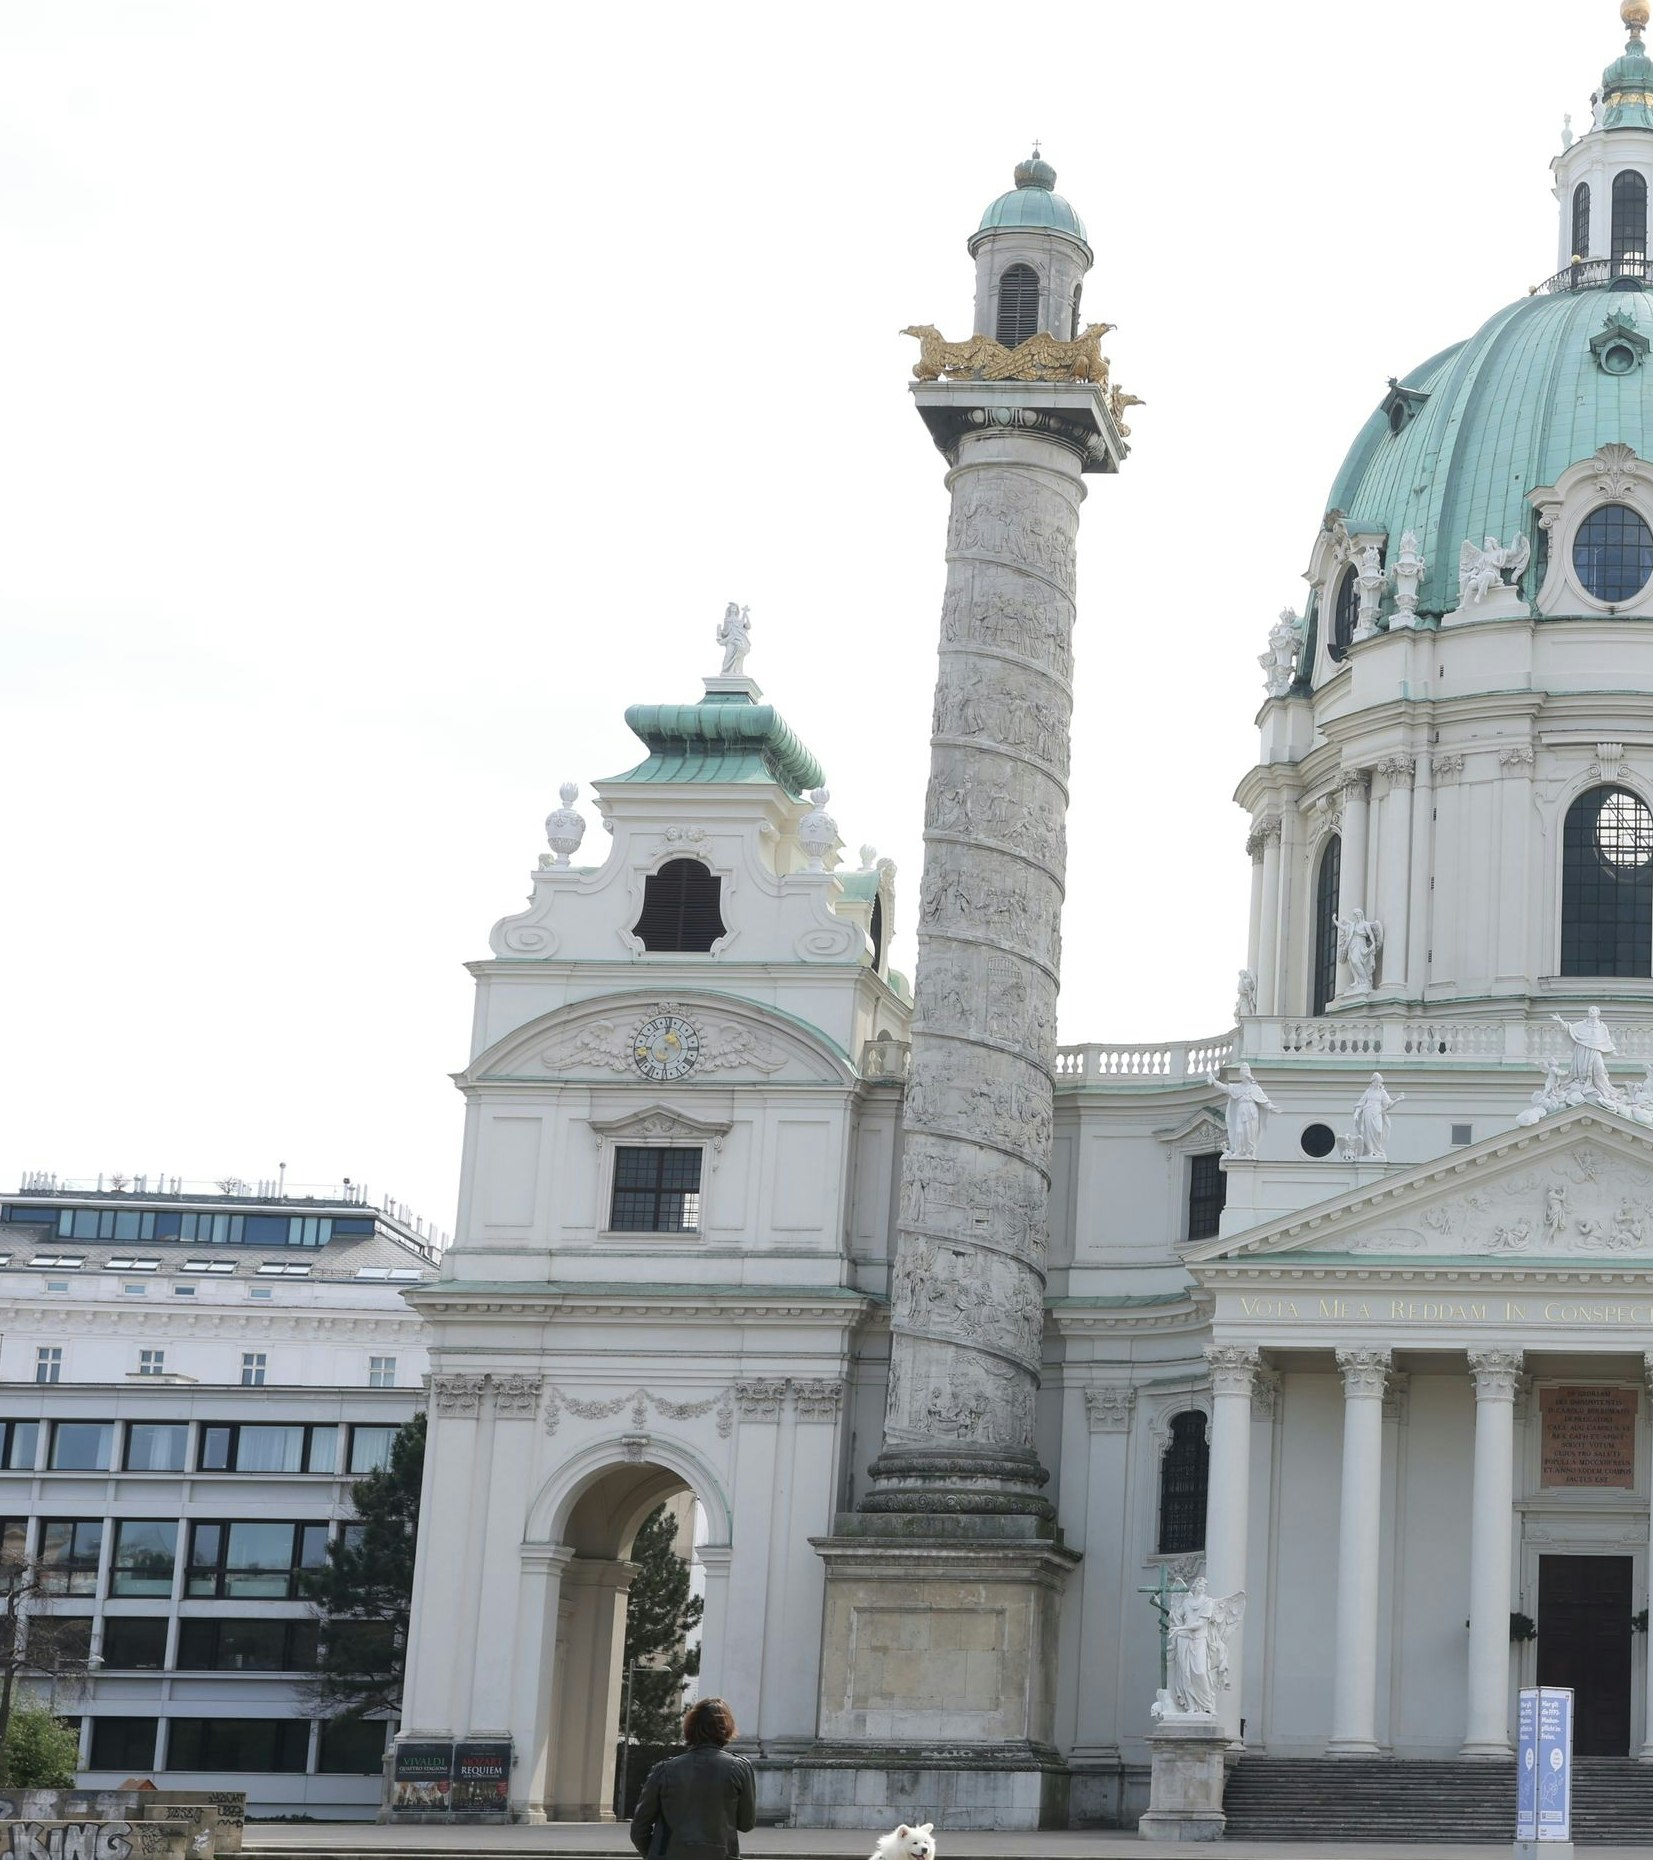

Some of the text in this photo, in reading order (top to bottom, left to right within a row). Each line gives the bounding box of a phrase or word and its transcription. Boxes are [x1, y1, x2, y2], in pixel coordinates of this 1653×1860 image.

[1240, 1298, 1299, 1317] VOTA
[1318, 1299, 1370, 1319] MEA
[1391, 1300, 1486, 1322] REDDAM
[1505, 1301, 1526, 1321] IN
[404, 1757, 445, 1766] VIVALDI
[461, 1766, 502, 1776] REQUIEM
